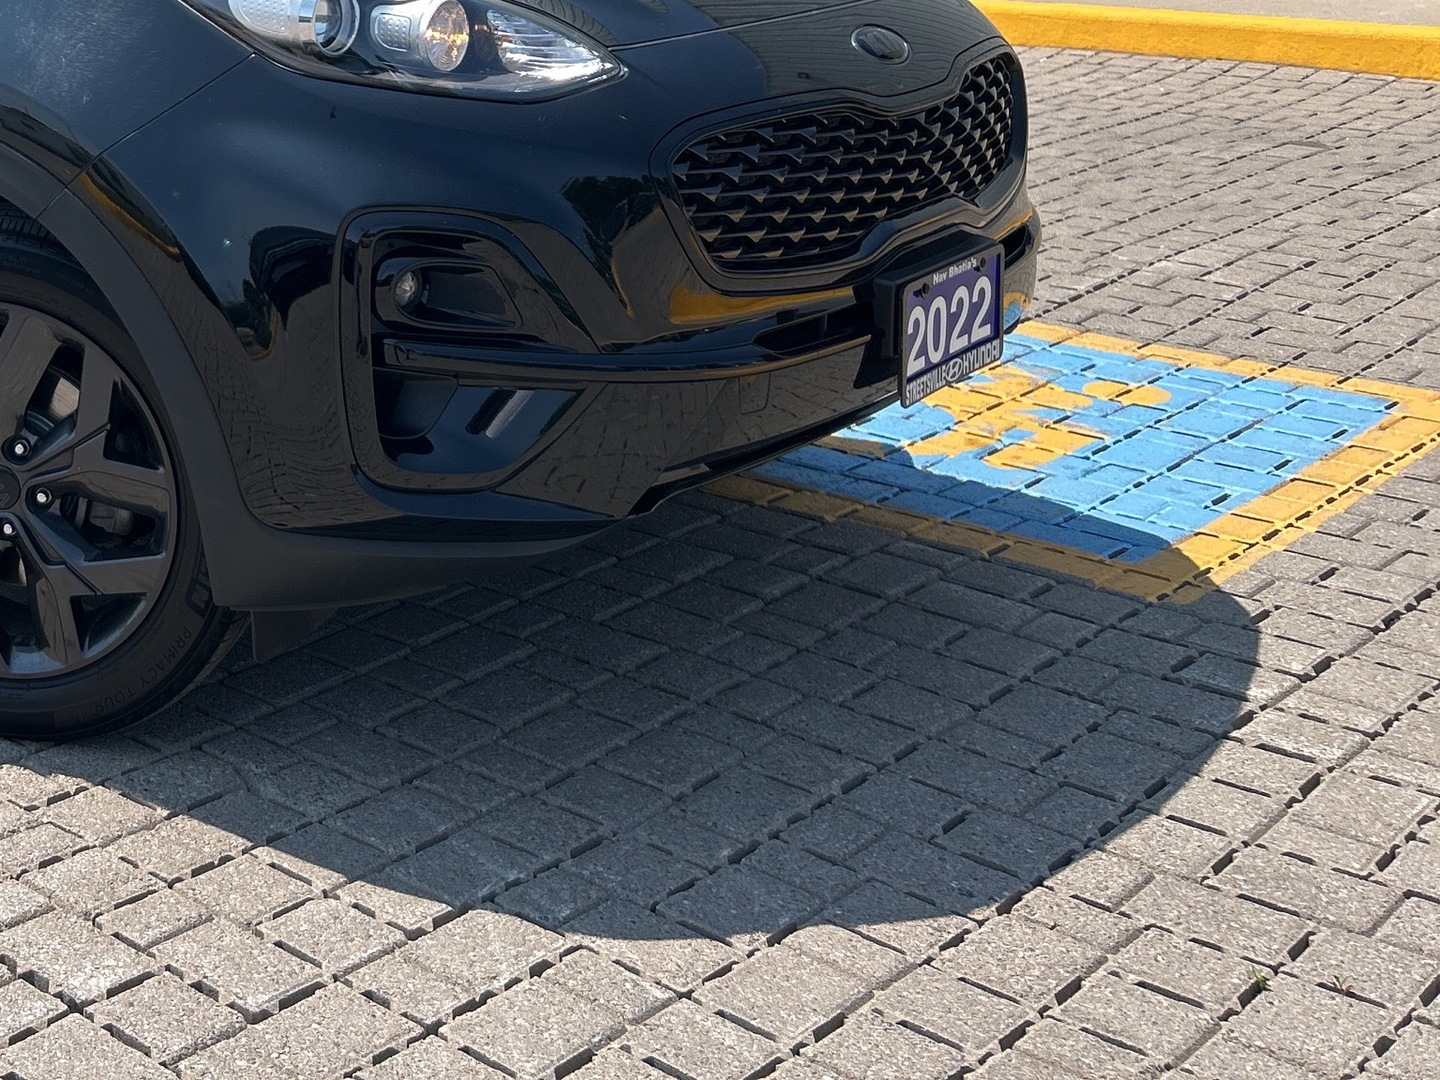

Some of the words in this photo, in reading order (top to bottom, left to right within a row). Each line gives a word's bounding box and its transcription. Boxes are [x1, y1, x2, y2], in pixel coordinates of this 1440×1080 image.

[932, 271, 947, 285] Nav
[948, 256, 978, 277] Bhatia's
[906, 275, 992, 377] 2022
[905, 366, 947, 406] STREETSVILLE
[962, 338, 1000, 375] HYUNDAI
[140, 625, 192, 688] PRIMACY
[94, 687, 137, 716] TOUR
